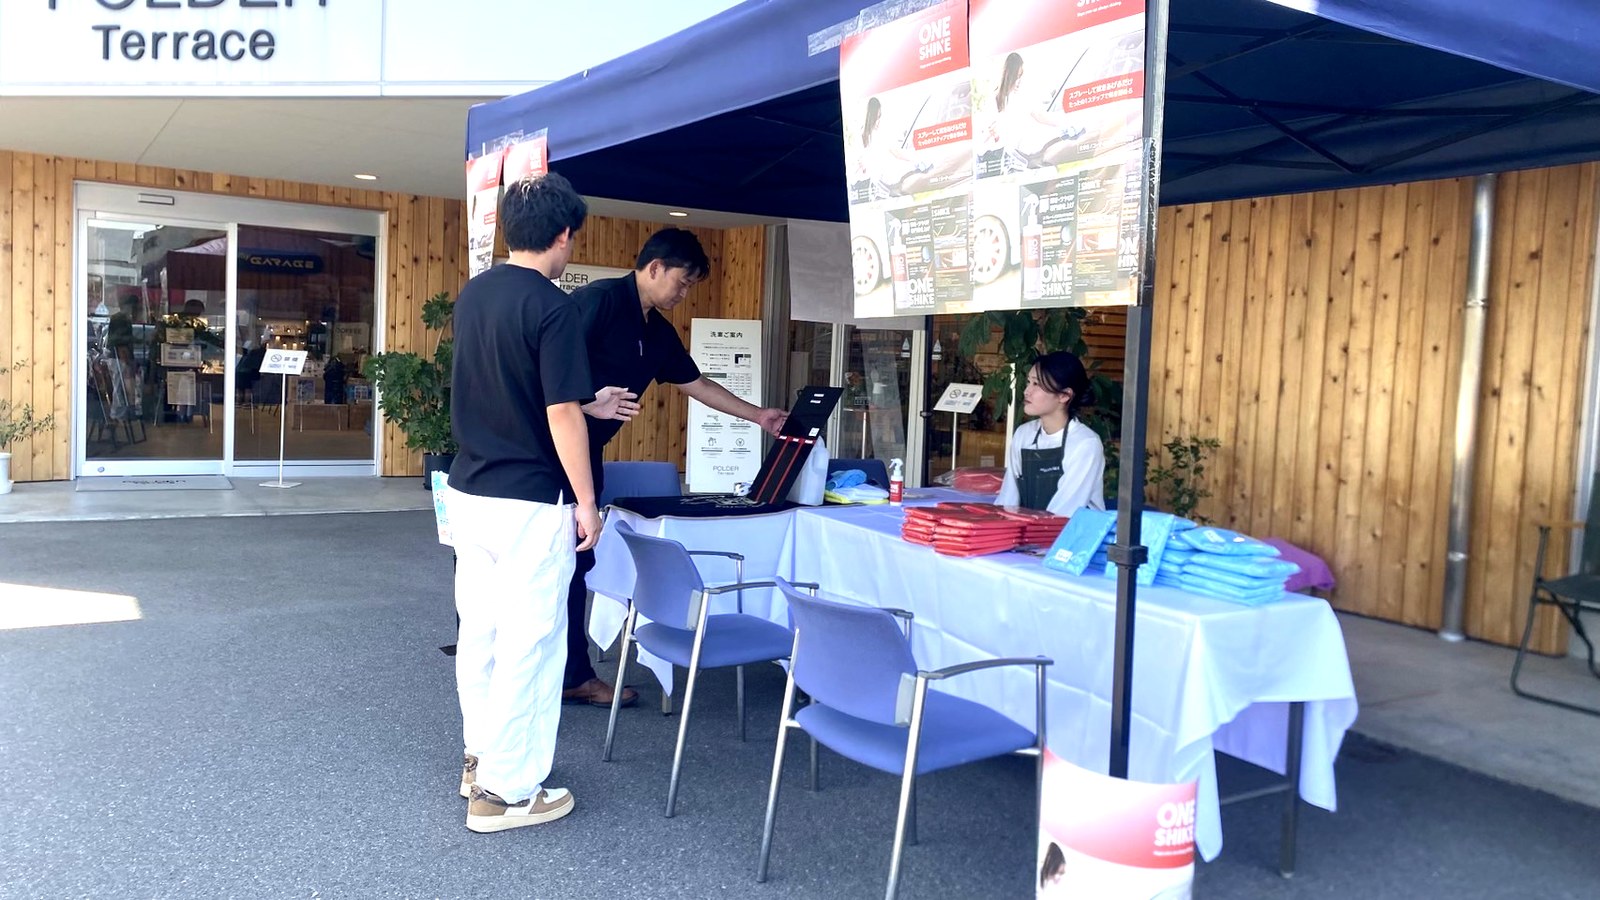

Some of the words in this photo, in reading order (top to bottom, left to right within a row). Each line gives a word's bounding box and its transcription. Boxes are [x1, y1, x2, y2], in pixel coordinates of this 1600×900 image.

[92, 24, 276, 61] Terrace
[918, 15, 951, 45] ONE
[909, 277, 935, 294] ONE
[1041, 263, 1073, 283] ONE
